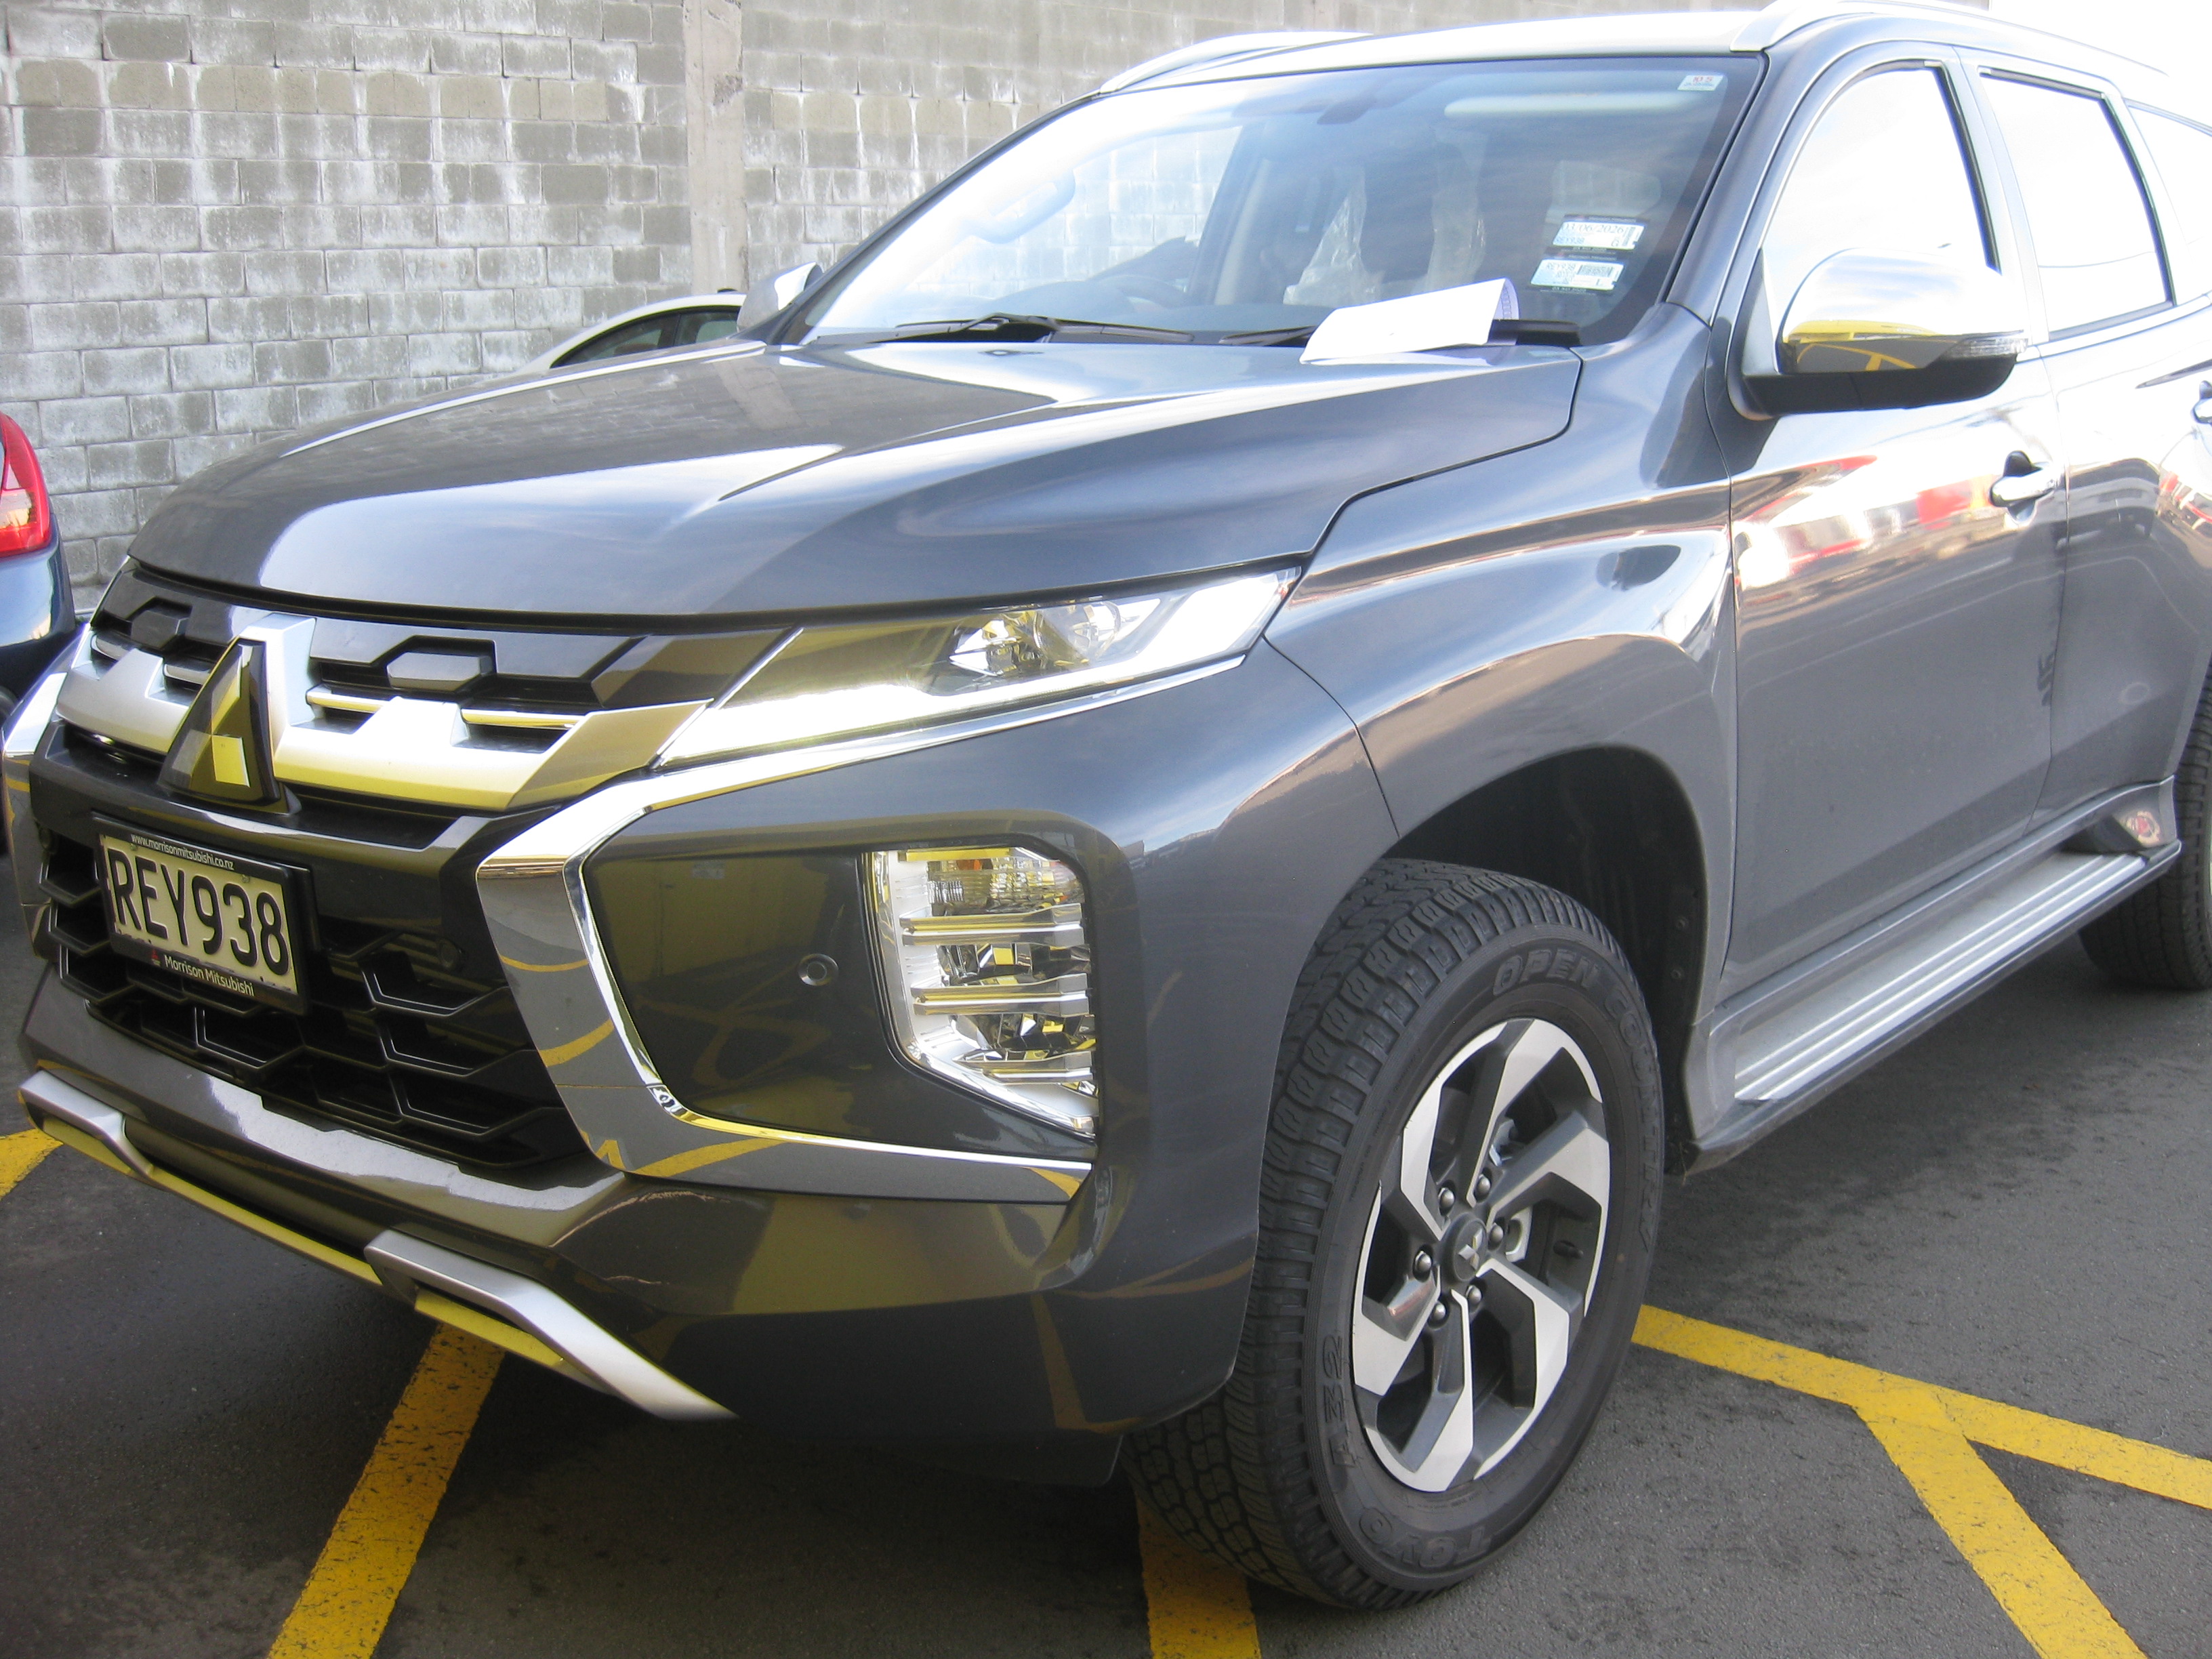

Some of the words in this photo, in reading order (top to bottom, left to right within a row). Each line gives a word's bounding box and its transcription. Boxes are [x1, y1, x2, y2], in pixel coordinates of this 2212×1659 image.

[1561, 223, 1624, 234] 03/06/2026
[131, 834, 234, 871] www.morrisonmitsubishi.co.nz
[107, 847, 289, 976] REY938
[164, 954, 204, 979] Morrison
[205, 968, 255, 997] Mitsubishi
[1493, 949, 1602, 996] OPEN
[1603, 989, 1659, 1253] COUNTRY
[1359, 1507, 1486, 1568] TOYO
